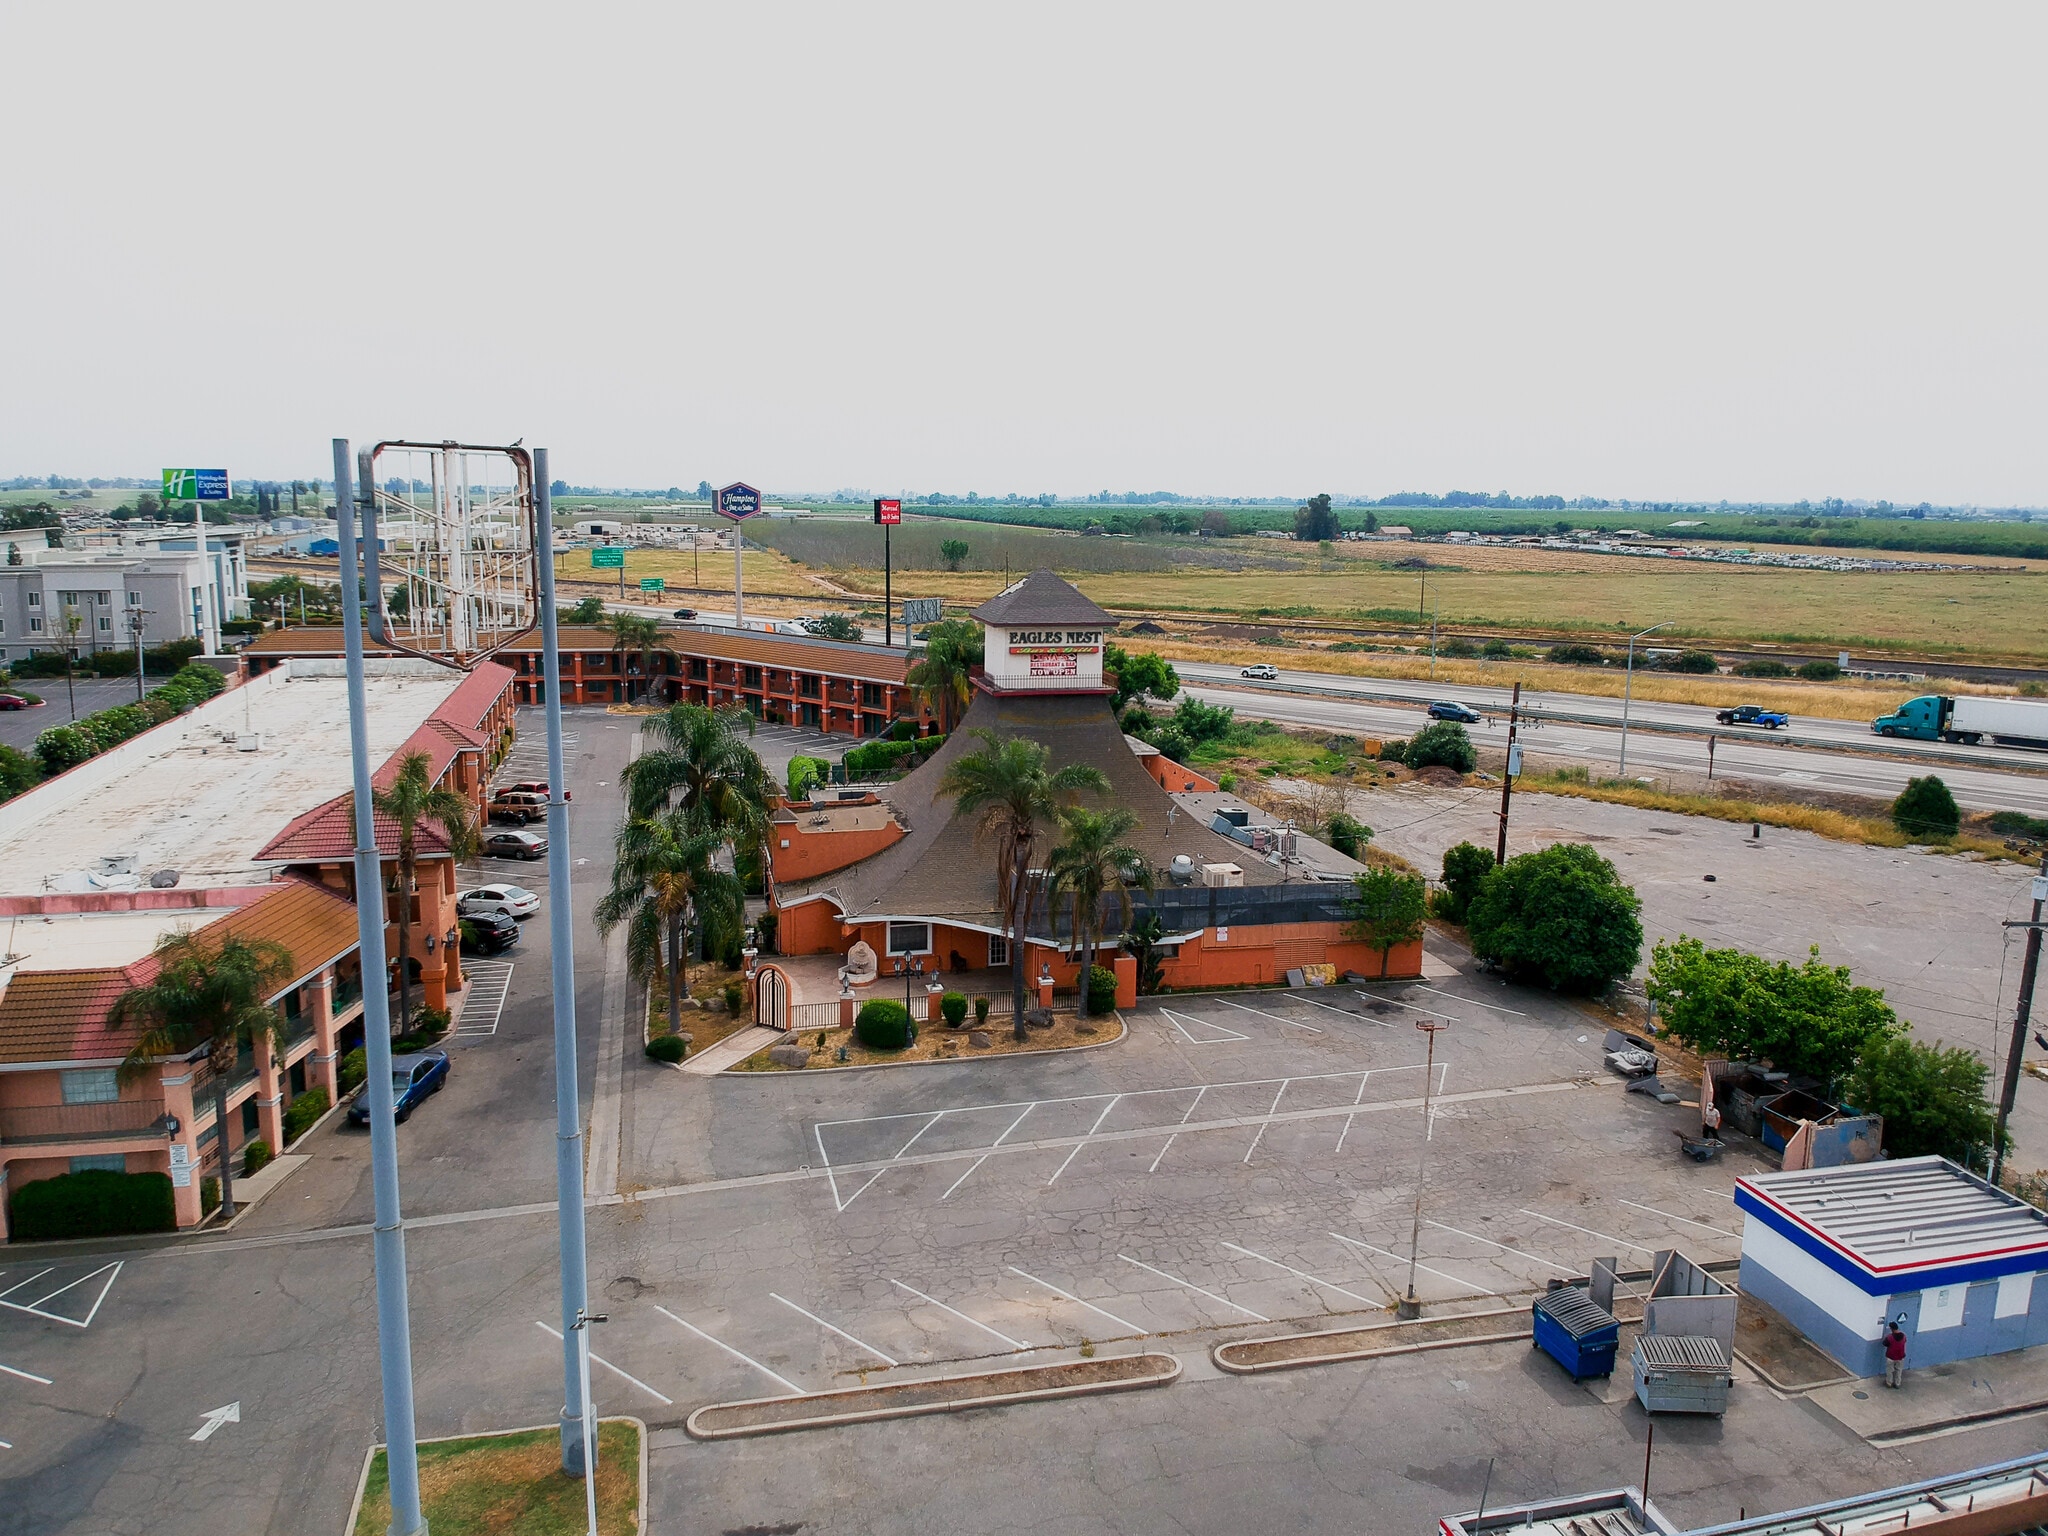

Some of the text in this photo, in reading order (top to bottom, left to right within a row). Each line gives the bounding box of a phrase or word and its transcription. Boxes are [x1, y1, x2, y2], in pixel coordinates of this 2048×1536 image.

[723, 493, 757, 504] Hampton
[1009, 632, 1101, 644] EAGLES NEST
[1053, 668, 1076, 676] OPEN
